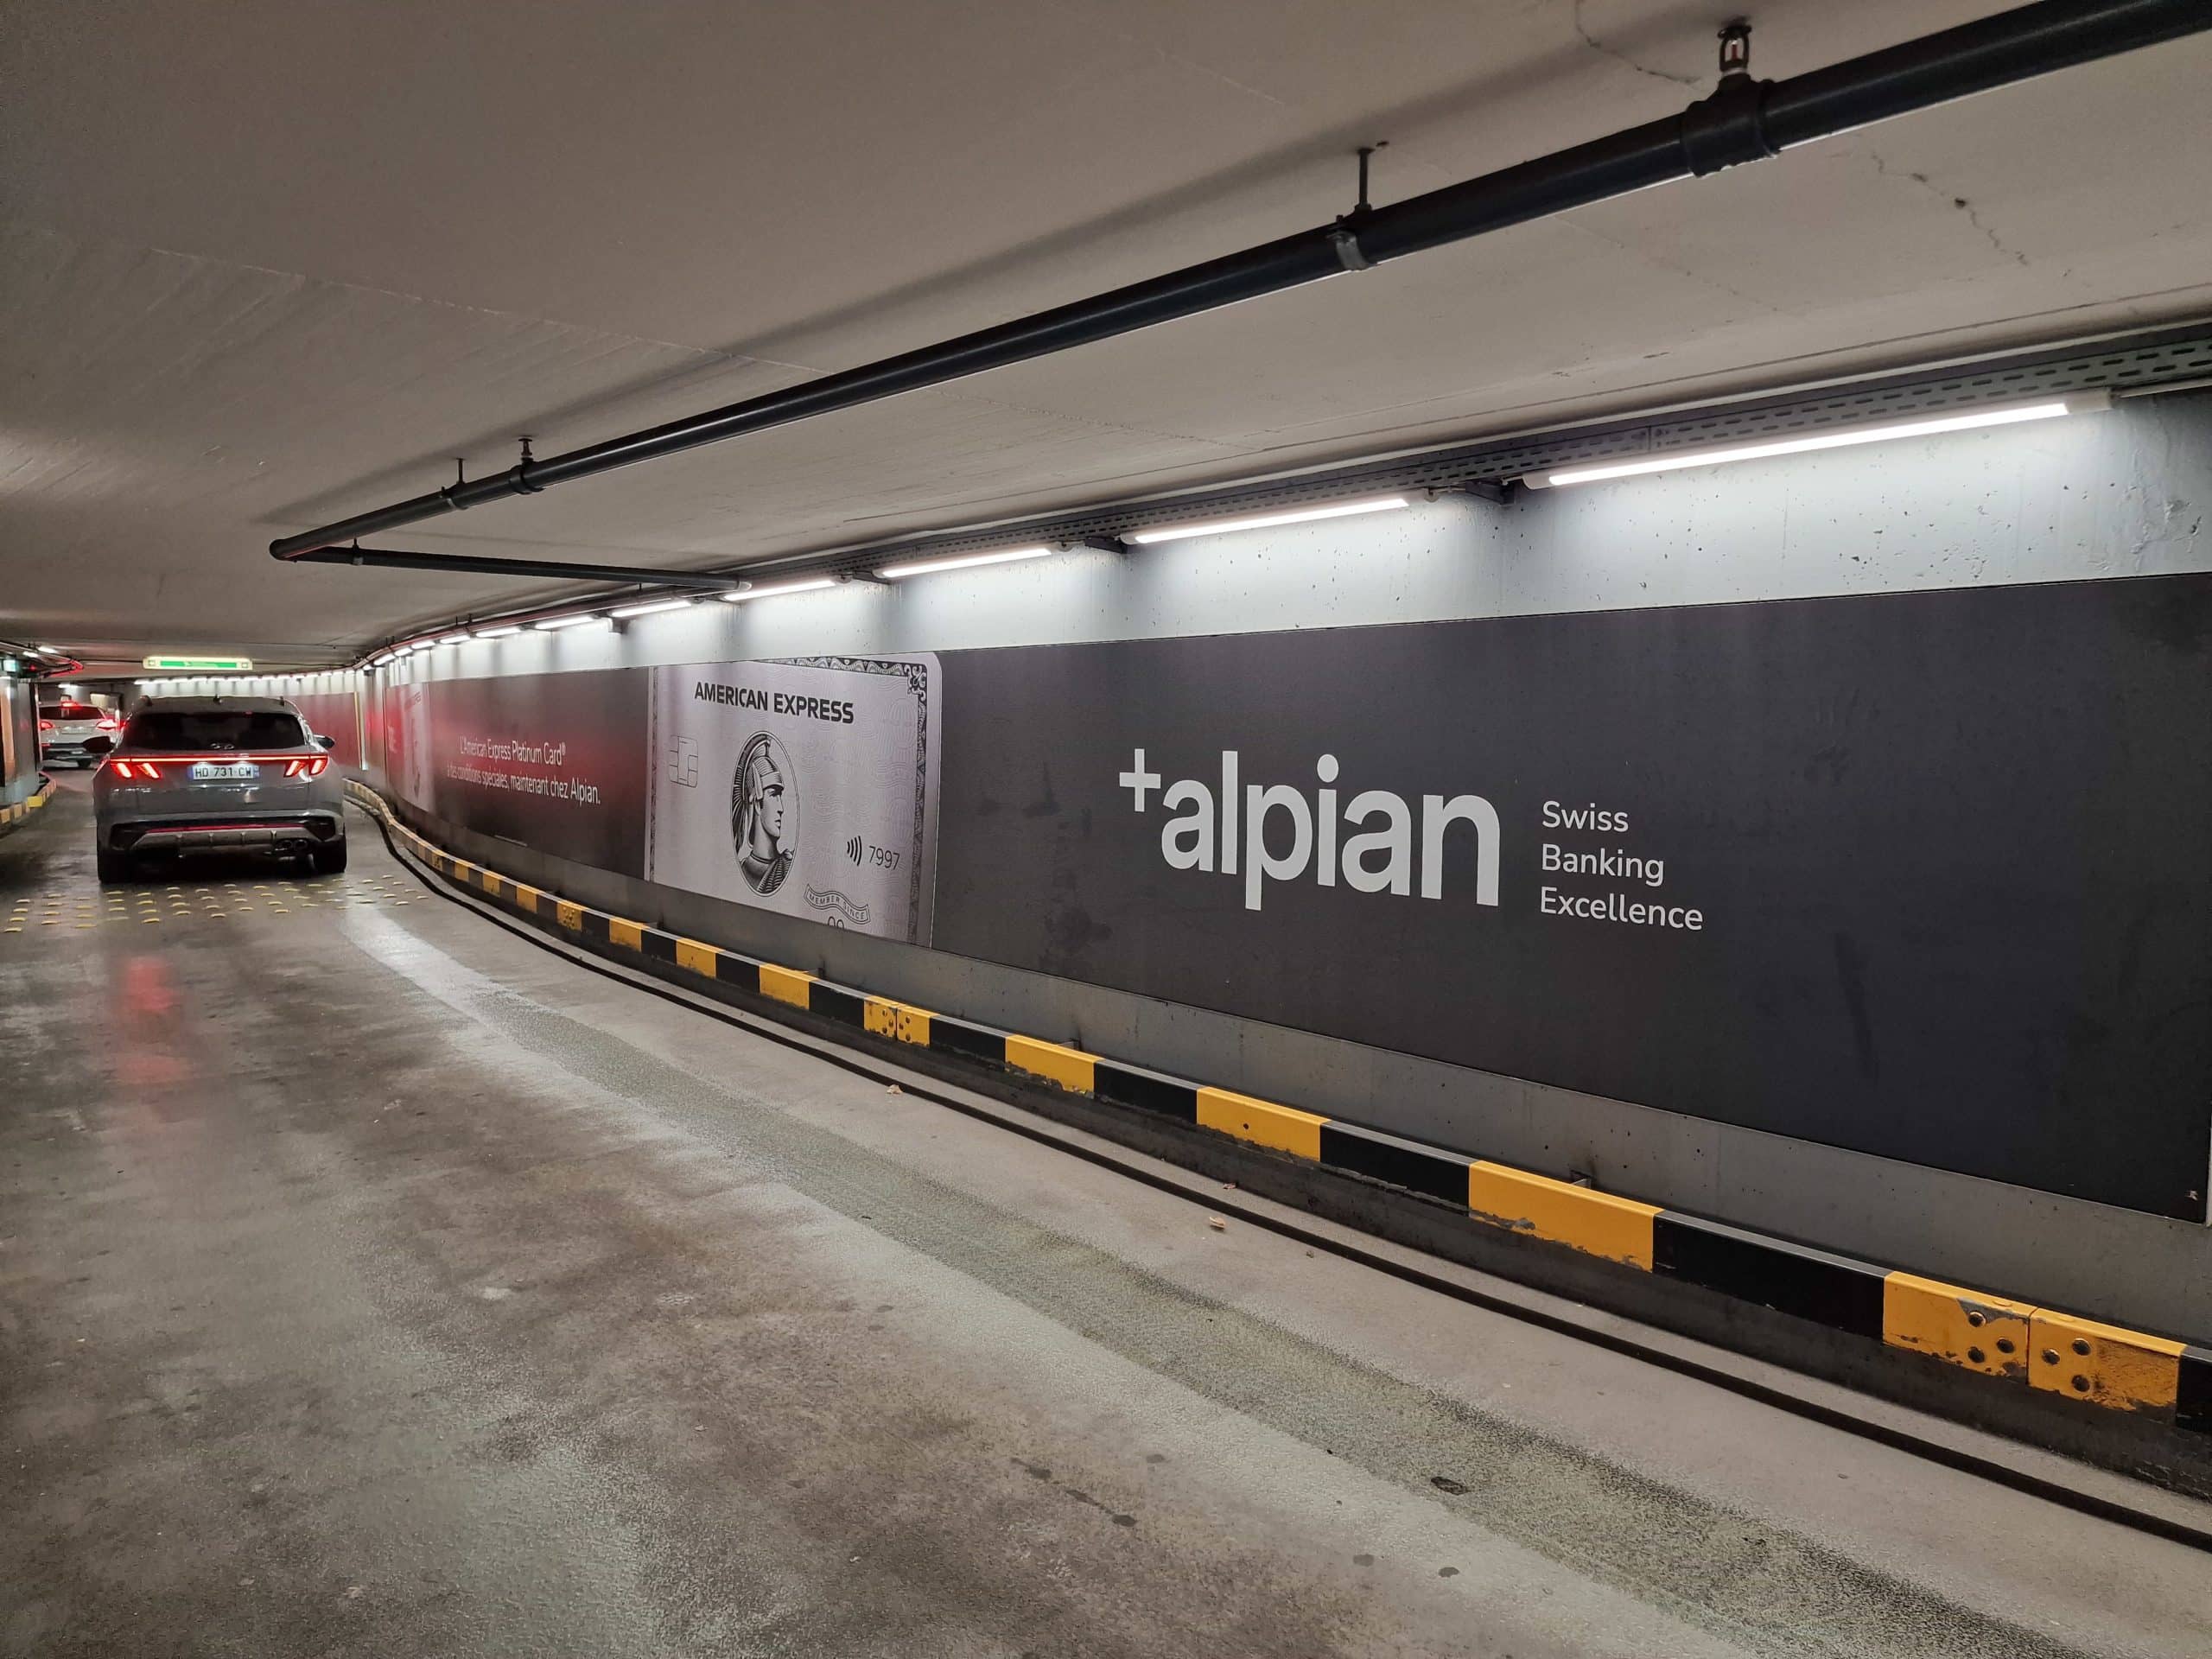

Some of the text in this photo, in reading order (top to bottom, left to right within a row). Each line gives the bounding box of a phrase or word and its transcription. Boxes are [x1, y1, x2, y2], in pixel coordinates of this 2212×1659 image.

[694, 681, 855, 725] AMERICAN EXPRESS
[487, 739, 512, 763] Express
[512, 740, 543, 765] Platinum
[510, 772, 550, 797] maintenant
[550, 775, 569, 799] chez
[570, 777, 601, 806] Alpian.
[1541, 800, 1630, 833] Swiss
[868, 845, 900, 870] 7997
[1541, 843, 1666, 887] Banking
[809, 893, 865, 920] MEMBER SINCE
[1540, 887, 1705, 931] Excellence
